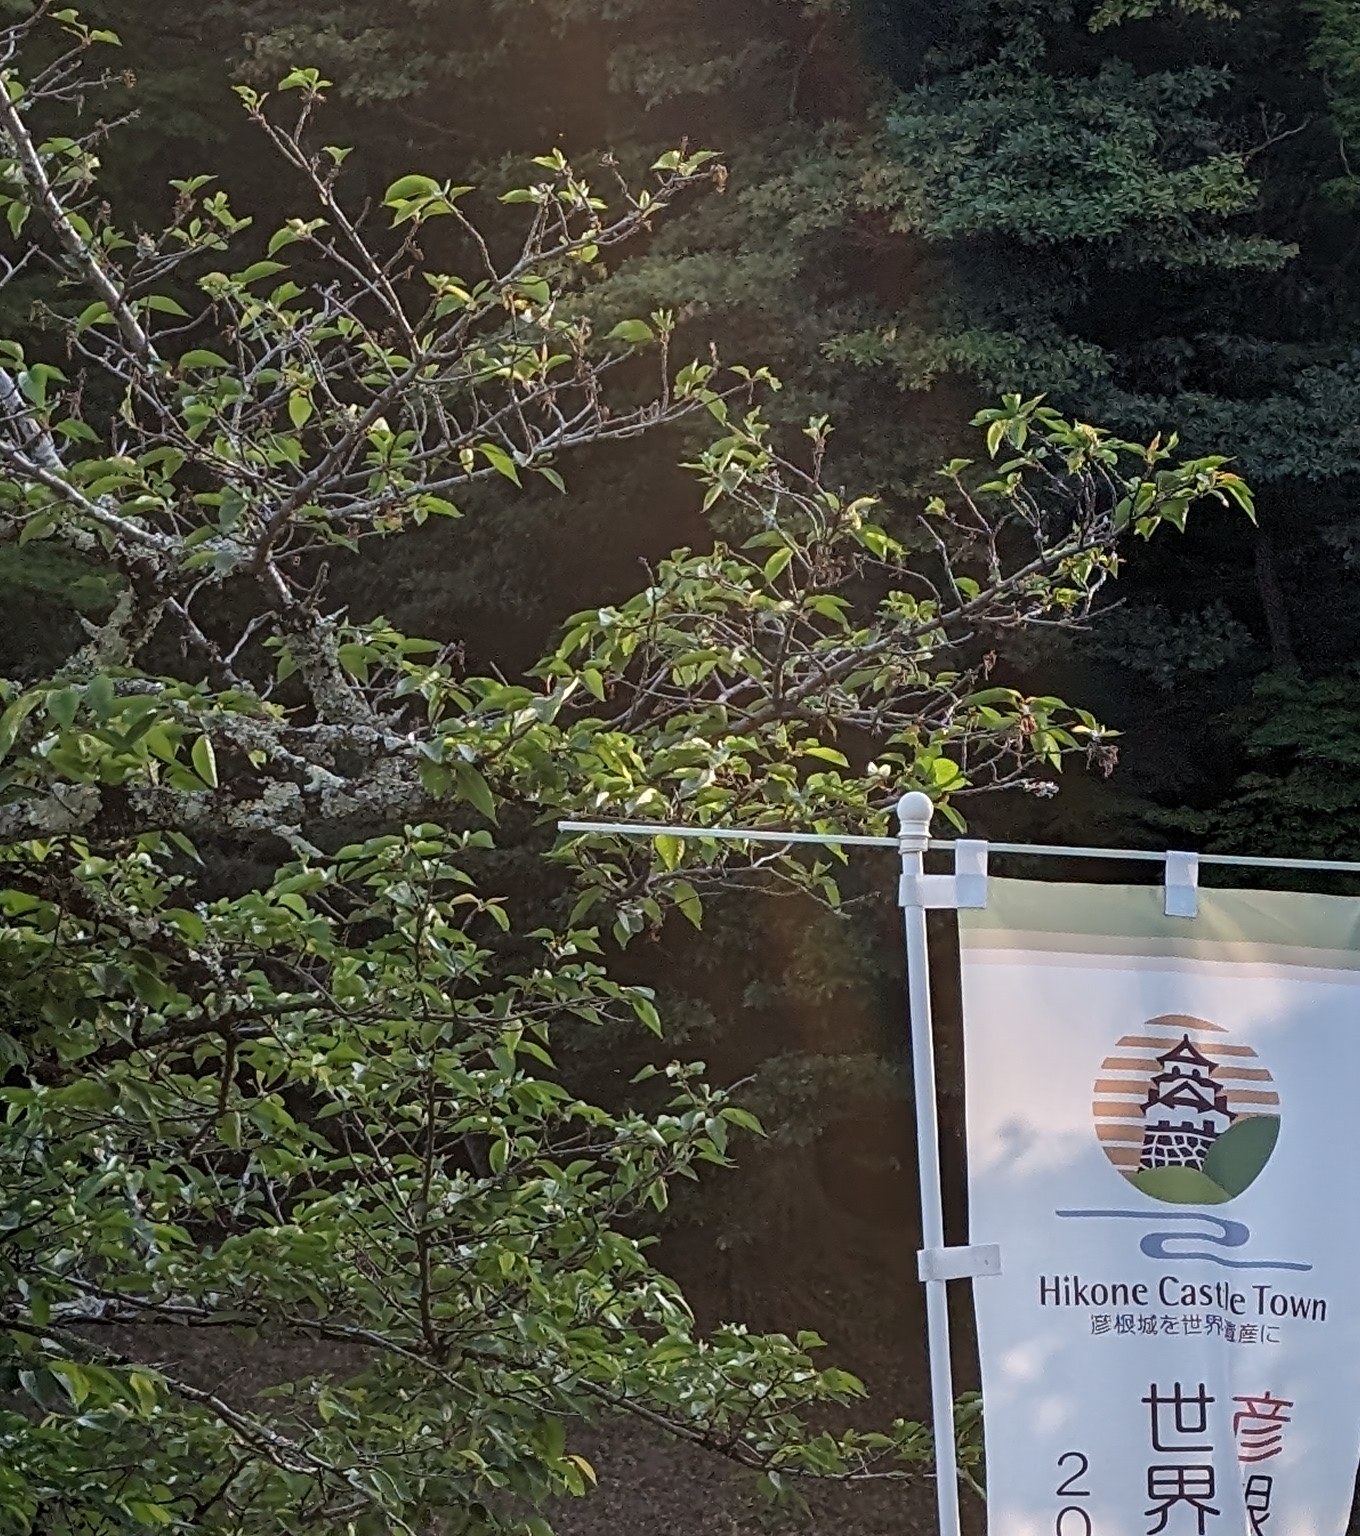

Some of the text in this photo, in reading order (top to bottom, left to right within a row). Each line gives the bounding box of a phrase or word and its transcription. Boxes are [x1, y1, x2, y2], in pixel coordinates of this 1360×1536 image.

[1039, 1274, 1327, 1322] Hikone Castle Town
